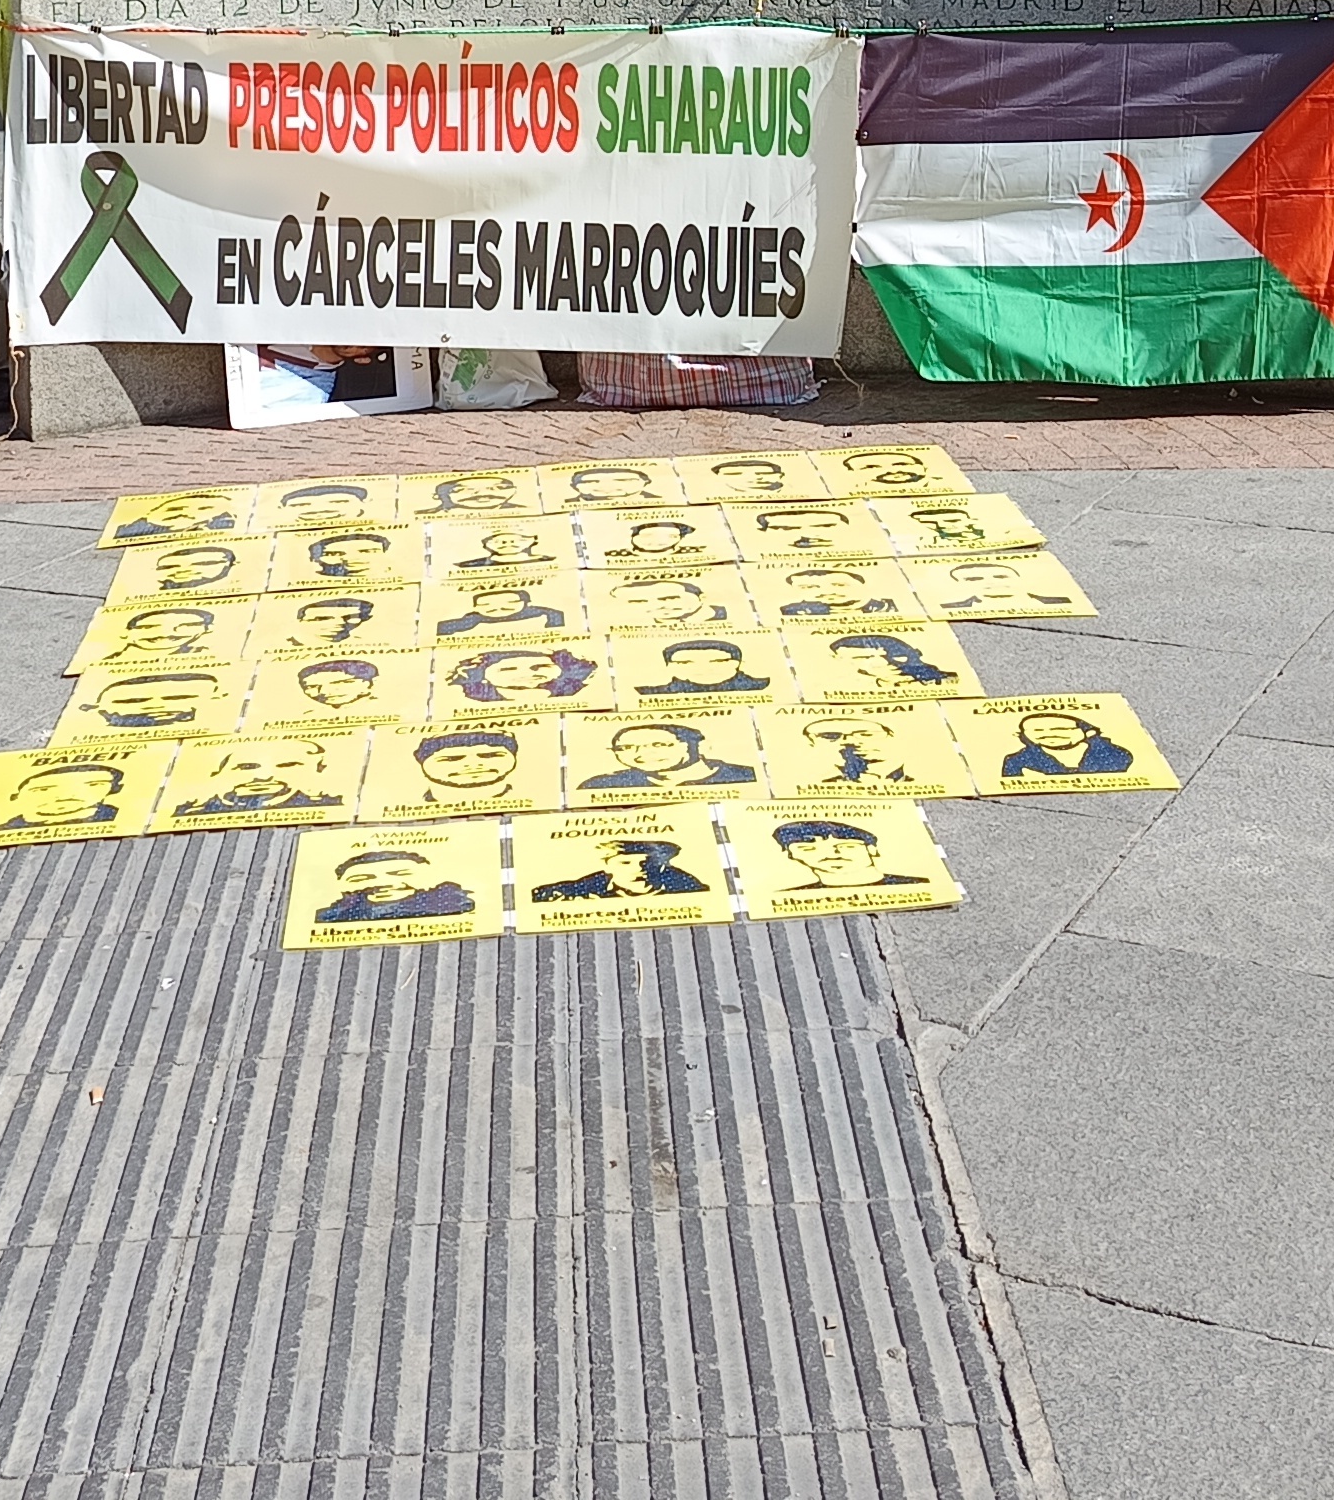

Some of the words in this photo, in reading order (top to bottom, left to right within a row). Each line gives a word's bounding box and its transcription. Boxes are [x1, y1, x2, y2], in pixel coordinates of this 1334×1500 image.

[50, 0, 94, 25] EL
[25, 54, 208, 146] LIBERTAD
[227, 61, 375, 154] PRESOS
[387, 41, 578, 154] POLÍTICOS
[595, 62, 812, 158] SAHARAUIS
[216, 237, 260, 306] EN
[274, 192, 502, 312] CÁRCELES
[514, 202, 806, 319] MARROQUÍES
[662, 709, 733, 721] ASFARI
[775, 707, 857, 717] AHMED
[862, 704, 915, 714] SBAI
[973, 703, 1101, 716] LAAROUSSI
[455, 717, 540, 732] BANGA
[30, 750, 136, 767] BABEIT
[566, 813, 657, 827] HUSSEIN
[370, 830, 428, 840] AYMAN
[550, 825, 675, 840] BOURAKBA
[771, 893, 860, 907] Libertad
[540, 907, 632, 921] Libertad
[310, 923, 401, 938] Libertad
